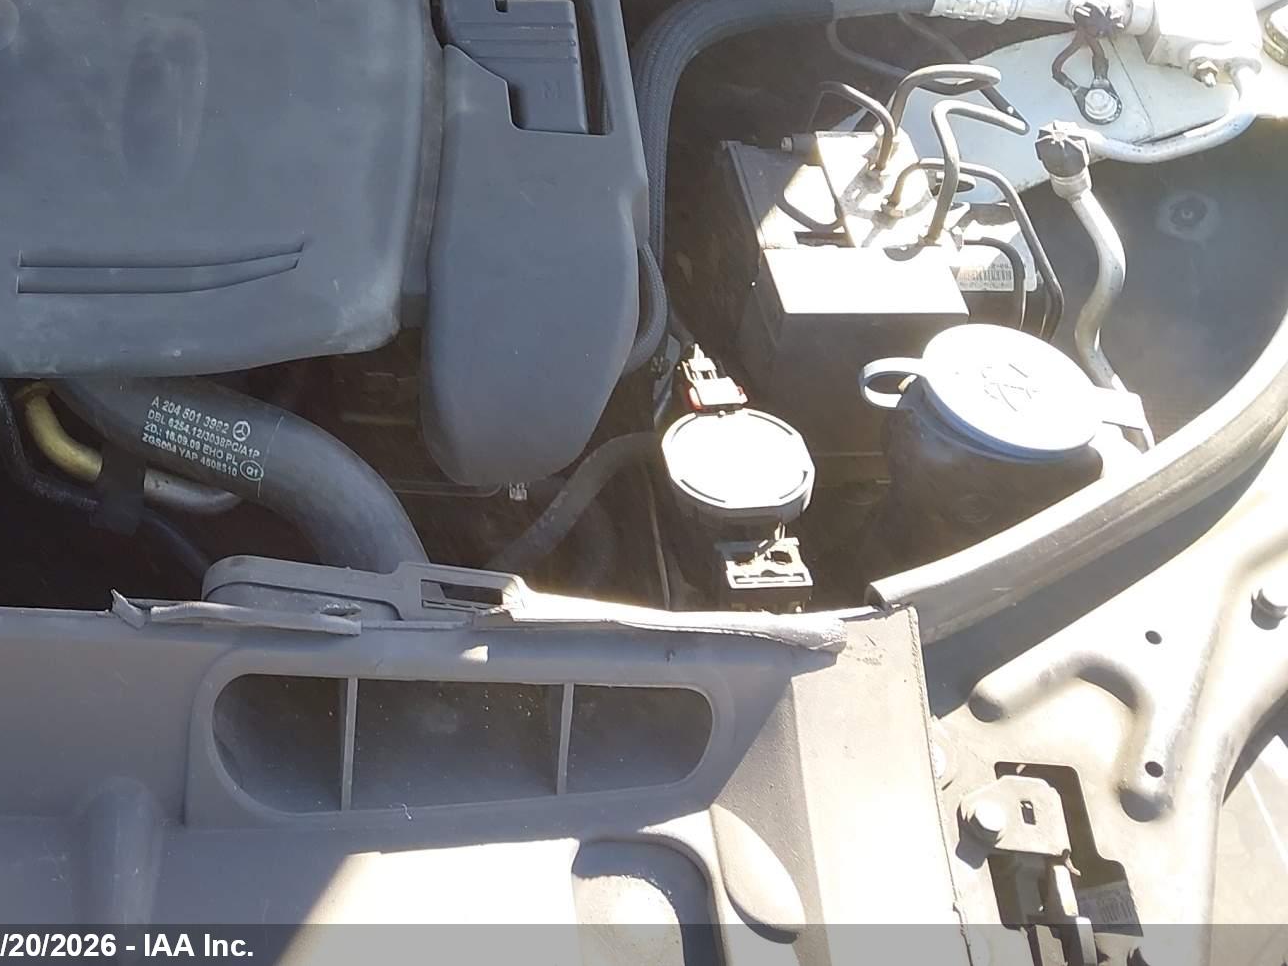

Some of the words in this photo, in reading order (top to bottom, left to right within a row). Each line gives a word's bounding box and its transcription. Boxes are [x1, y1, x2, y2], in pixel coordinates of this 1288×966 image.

[151, 395, 160, 409] A
[162, 400, 181, 416] 204
[147, 409, 166, 425] DBL
[225, 452, 238, 466] PL
